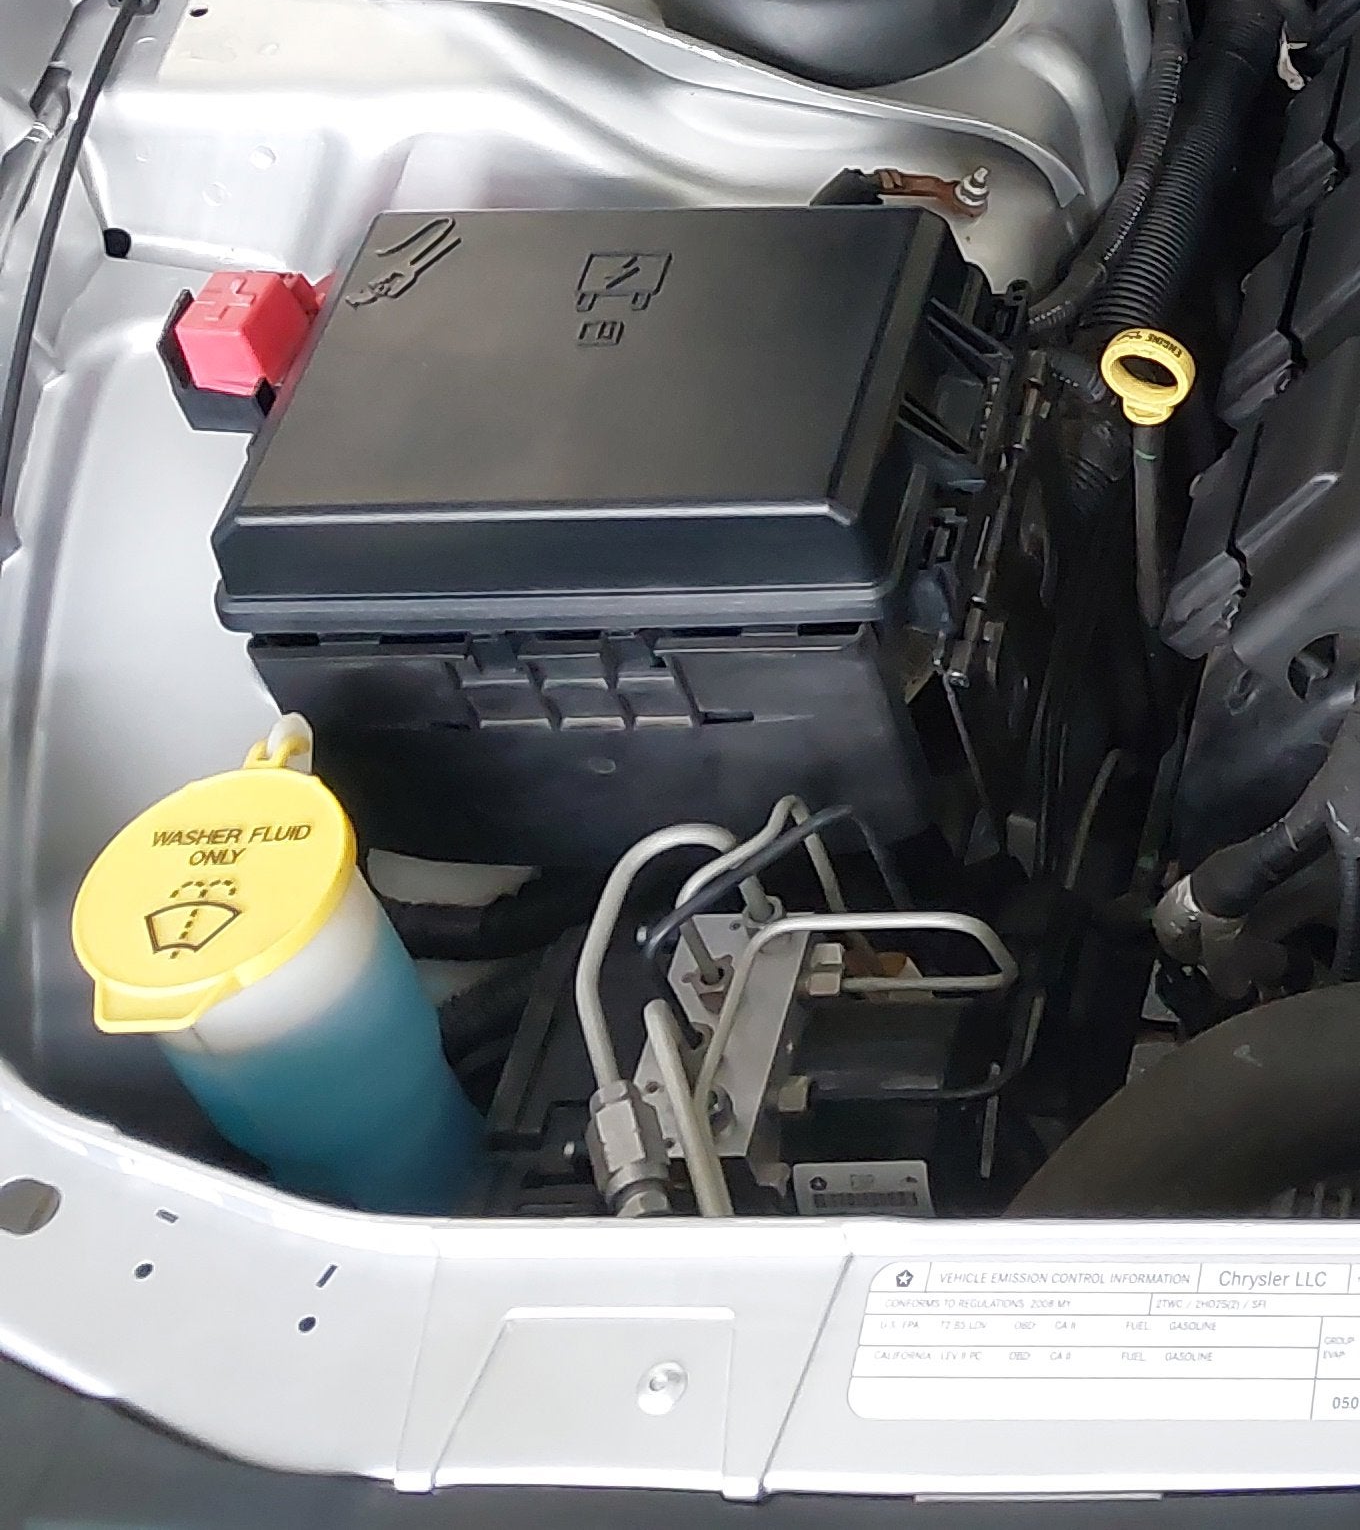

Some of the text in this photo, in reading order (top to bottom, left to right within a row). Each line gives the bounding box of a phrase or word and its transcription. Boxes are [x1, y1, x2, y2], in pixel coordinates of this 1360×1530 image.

[152, 824, 312, 847] WASHER FLUID
[189, 848, 246, 866] ONLY
[940, 1273, 1191, 1284] VEHICLE EMISSION CONTROL INFORMATION
[1219, 1270, 1327, 1290] Chrysler LLC
[959, 1299, 1025, 1308] REGULATIONS
[1169, 1321, 1217, 1331] GASOLINE
[874, 1351, 932, 1360] CALIFORNIA
[1165, 1352, 1213, 1361] GASOLINE
